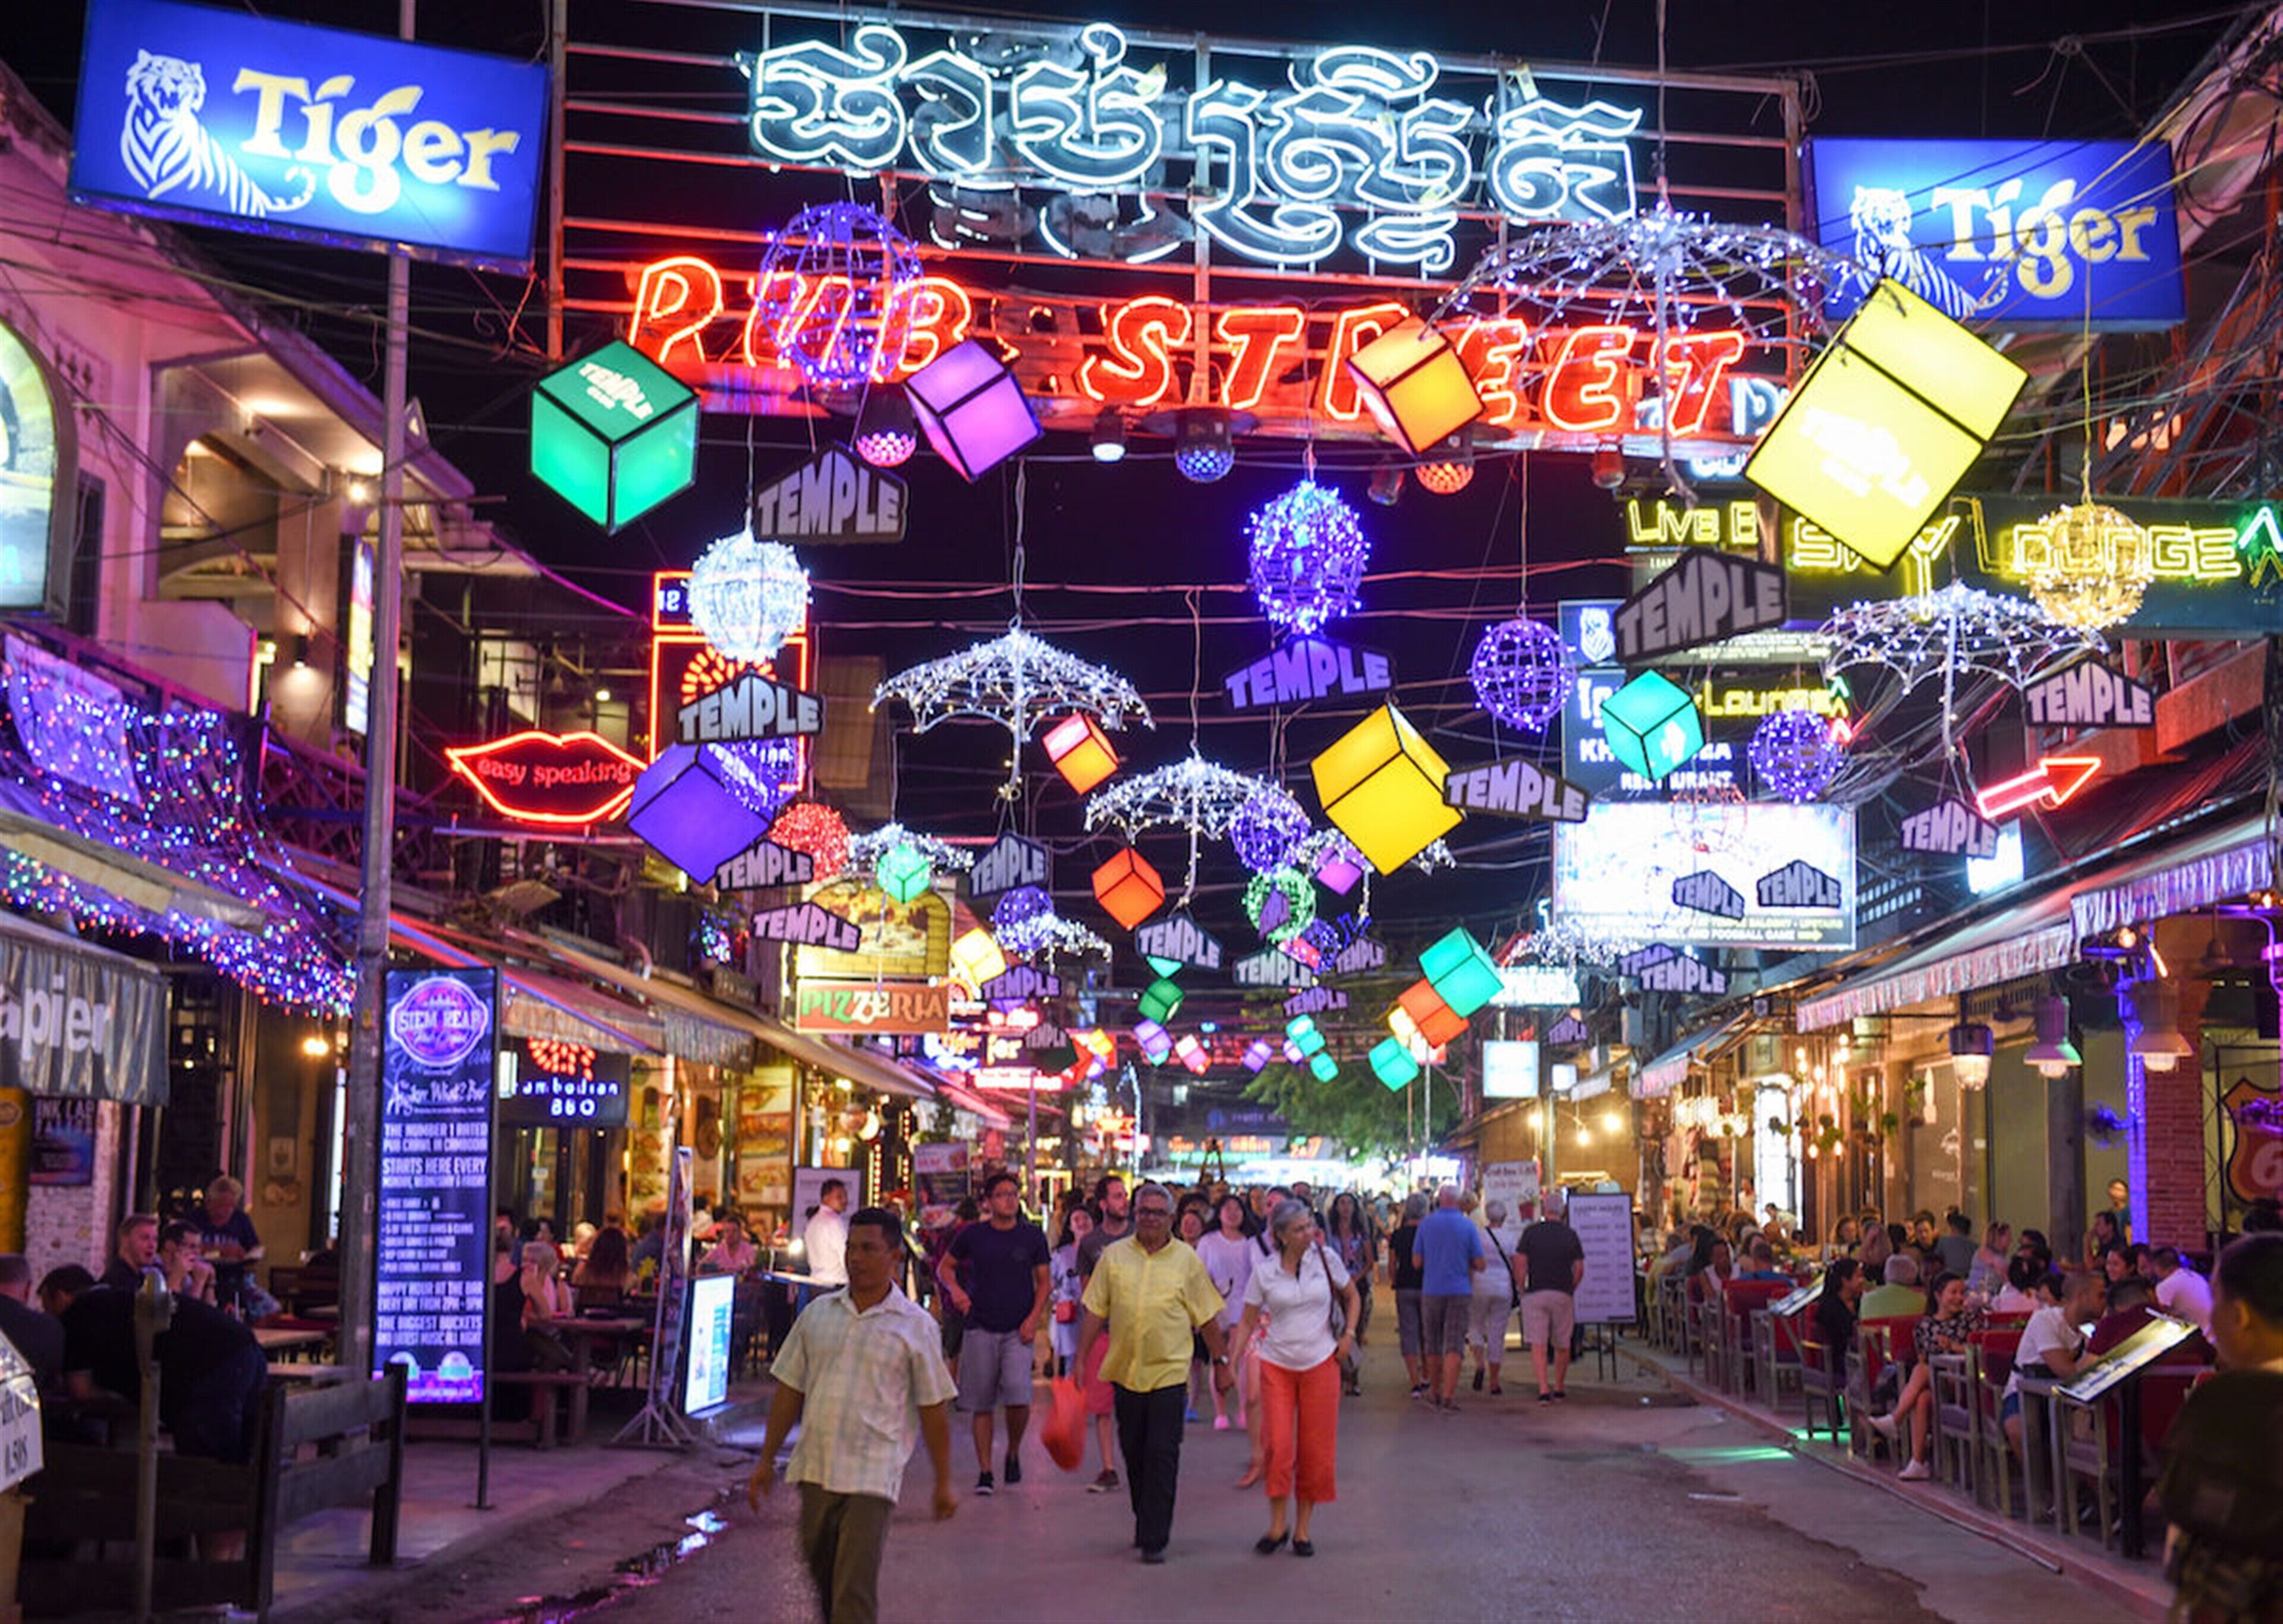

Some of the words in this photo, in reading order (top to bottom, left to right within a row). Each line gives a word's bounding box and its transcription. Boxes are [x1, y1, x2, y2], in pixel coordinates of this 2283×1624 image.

[233, 68, 521, 213] Tiger
[1931, 180, 2157, 298] Tiger
[629, 256, 971, 382] PUB
[758, 451, 900, 535] TEMPLE
[1618, 555, 1782, 658] TEMPLE
[1225, 640, 1391, 708] TEMPLE
[2026, 662, 2151, 723] TEMPLE
[678, 673, 820, 742] TEMPLE
[477, 759, 527, 785] easy
[533, 760, 631, 788] speaking
[1446, 760, 1586, 821] TEMPLE
[1902, 800, 1995, 855] TEMPLE
[718, 841, 812, 890] TEMPLE
[971, 839, 1046, 893] TEMPLE
[1759, 863, 1840, 905] TEMPLE
[1677, 872, 1744, 918] TEMPLE
[753, 904, 859, 949] TEMPLE
[1139, 916, 1221, 968] TEMPLE
[983, 967, 1059, 999] TEMPLE
[1237, 950, 1312, 987] TEMPLE
[1641, 957, 1726, 993] TEMPLE
[801, 990, 947, 1024] PIZZERIA
[1284, 987, 1348, 1016] TEMPLE
[515, 1077, 620, 1095] ambodian
[383, 1157, 423, 1174] STARTS
[425, 1157, 452, 1174] HERE
[454, 1157, 487, 1174] EVERY
